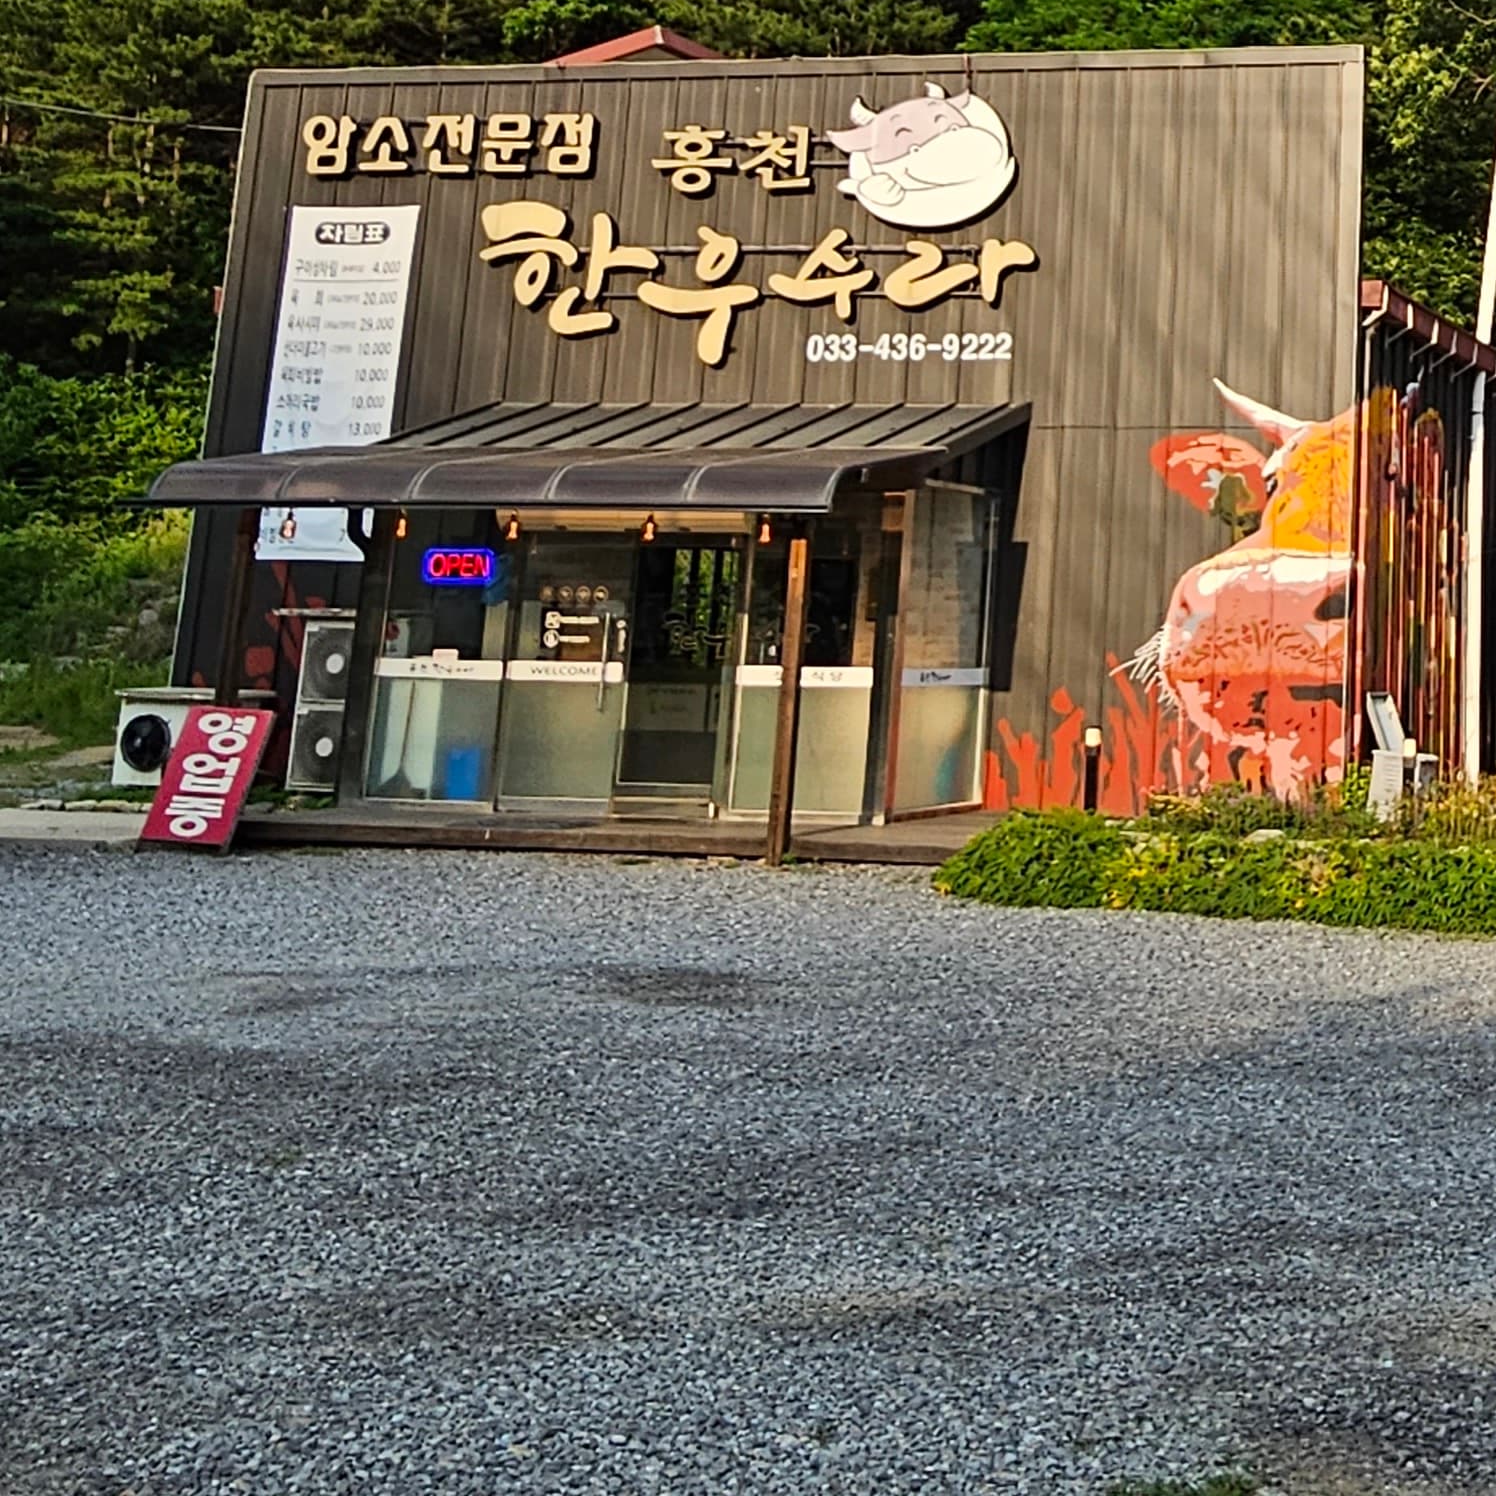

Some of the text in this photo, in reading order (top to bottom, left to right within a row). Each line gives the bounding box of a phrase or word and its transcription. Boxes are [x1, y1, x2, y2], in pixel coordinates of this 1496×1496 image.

[303, 113, 594, 175] 암소전문점
[651, 125, 813, 193] 홍천
[480, 201, 1036, 365] 한우수라
[806, 332, 1013, 362] 033-436-9222
[430, 553, 490, 577] OPEN
[531, 666, 598, 675] WELCOME
[164, 712, 257, 837] 영업중
